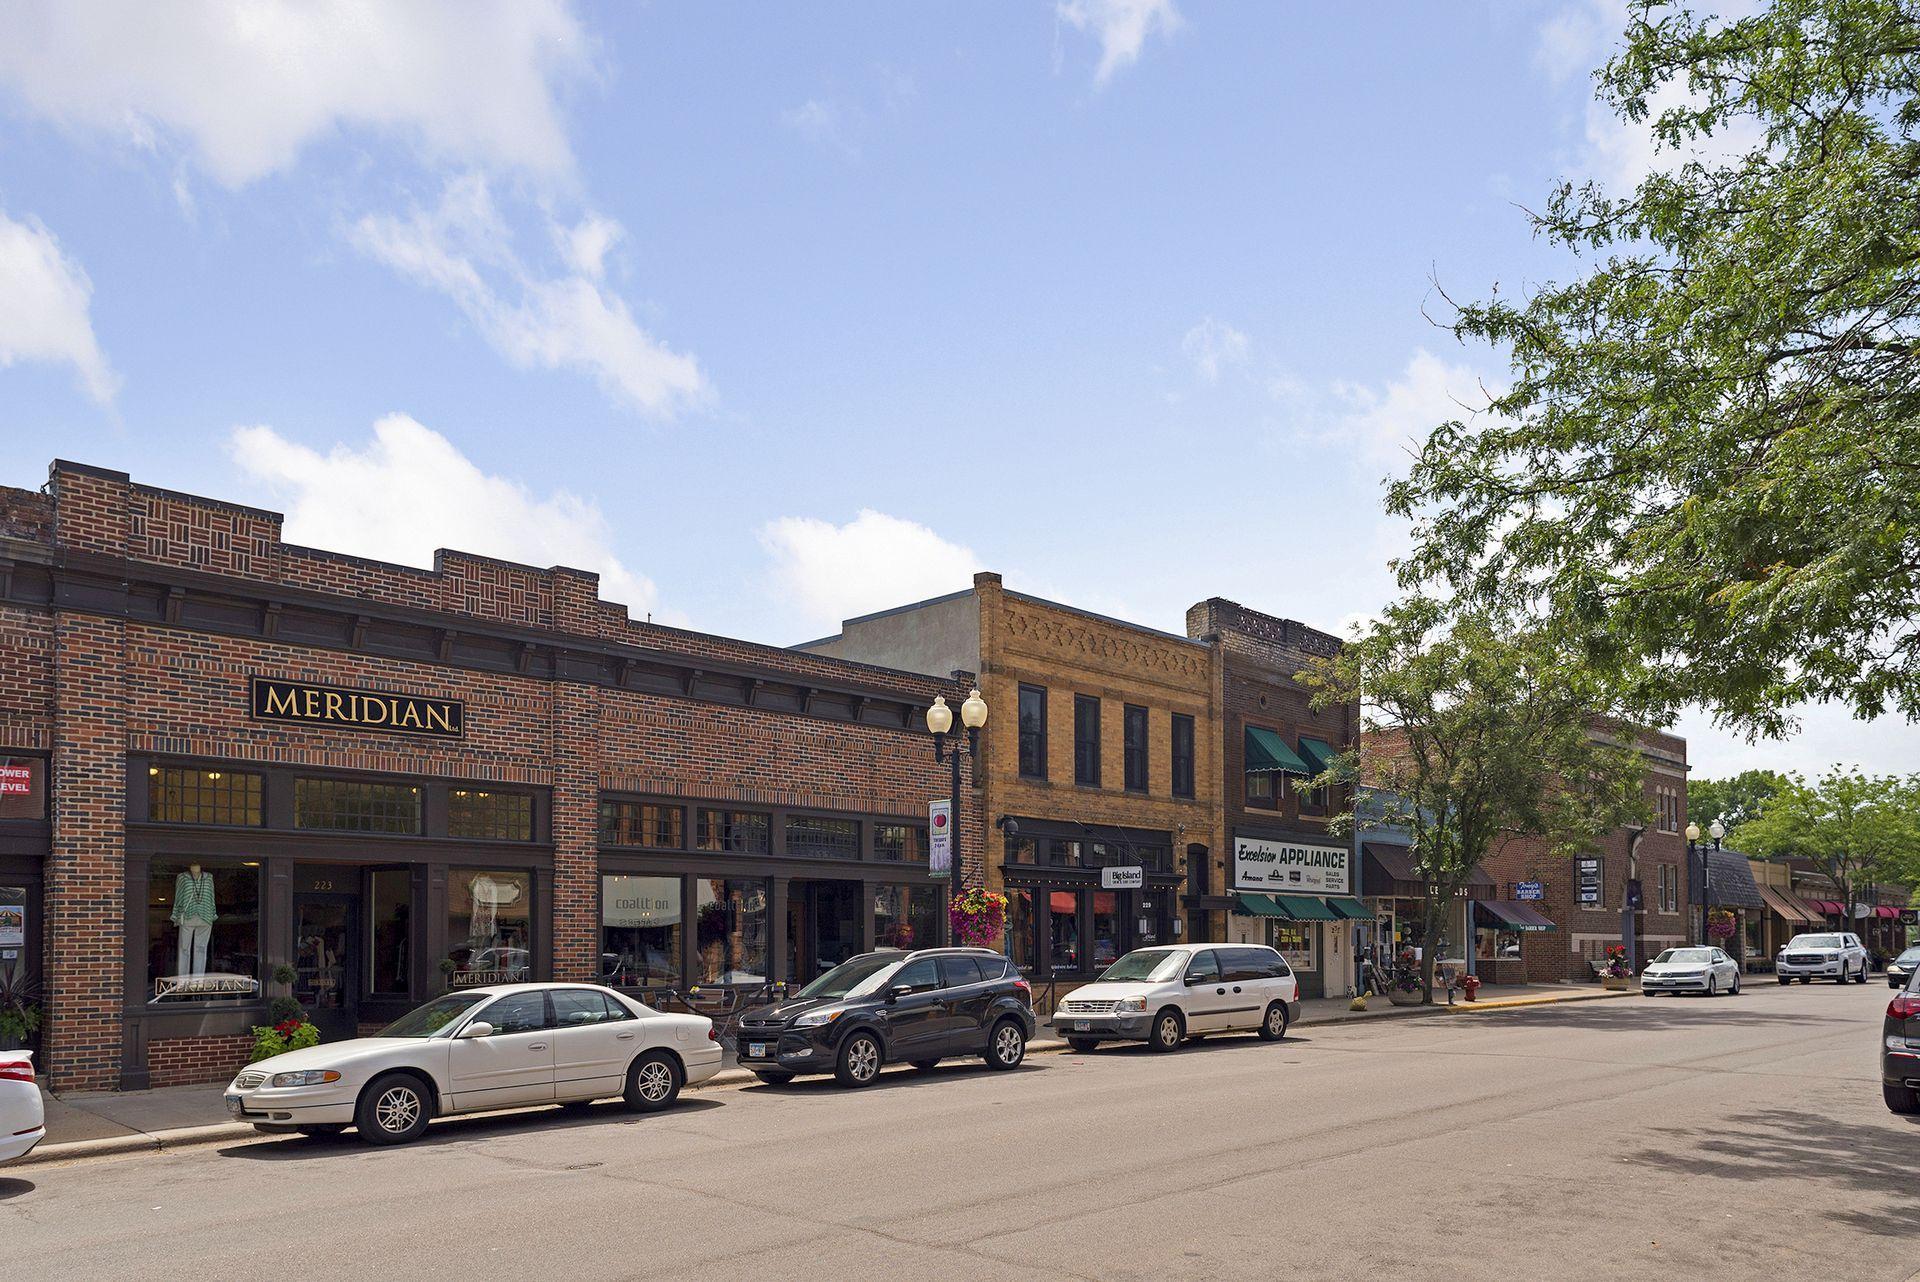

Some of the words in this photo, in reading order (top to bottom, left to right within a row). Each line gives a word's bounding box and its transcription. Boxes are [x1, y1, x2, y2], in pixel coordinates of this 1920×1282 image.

[264, 685, 450, 732] MERIDIAN
[0, 782, 29, 792] EVEL
[1239, 844, 1277, 863] Excelsior
[1280, 847, 1345, 869] APPLIANCE
[314, 880, 332, 890] 223
[456, 972, 519, 984] MERIDIAN
[159, 979, 245, 993] MERIDIAN
